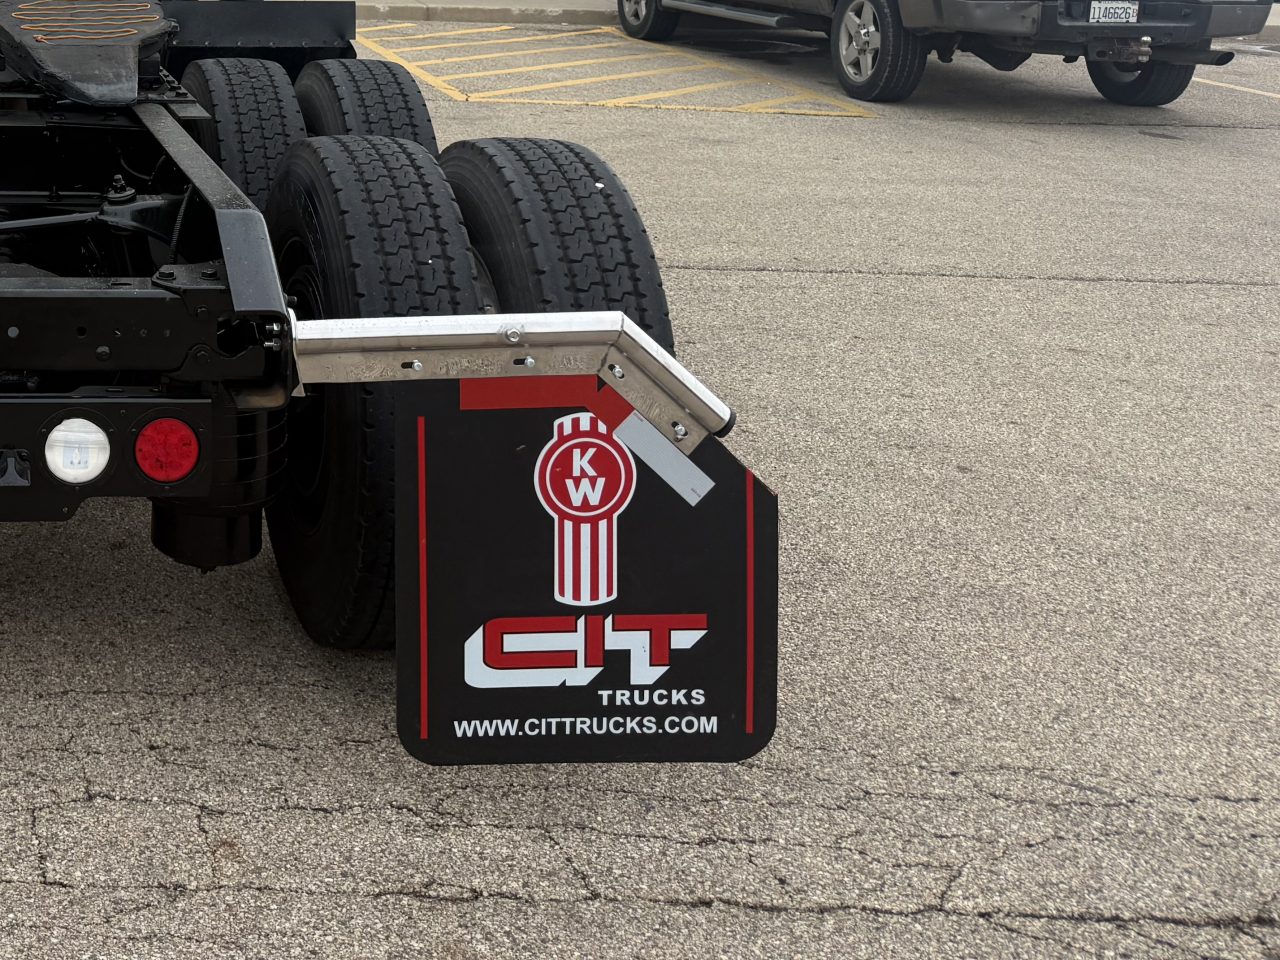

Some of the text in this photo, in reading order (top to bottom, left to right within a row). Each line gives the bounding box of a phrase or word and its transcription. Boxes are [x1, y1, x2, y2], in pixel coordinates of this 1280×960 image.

[572, 448, 598, 477] K
[565, 477, 606, 507] W
[464, 613, 708, 688] CIT
[597, 689, 706, 706] TRUCKS
[453, 715, 718, 738] WWW.CITTRUCKS.COM
